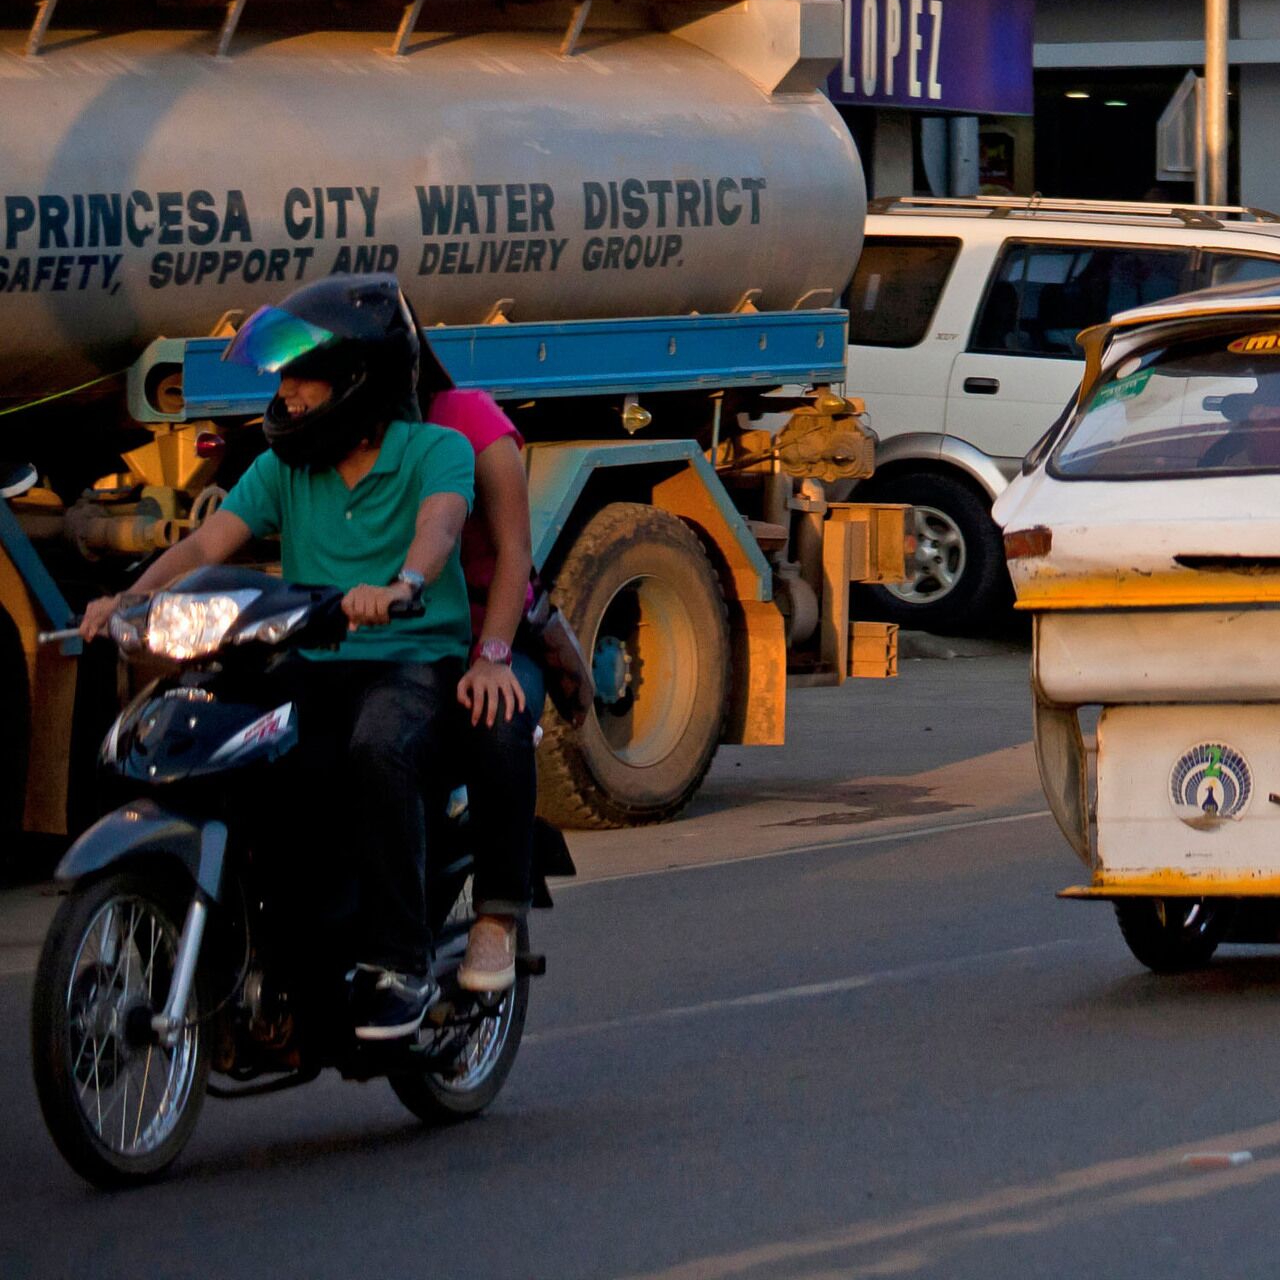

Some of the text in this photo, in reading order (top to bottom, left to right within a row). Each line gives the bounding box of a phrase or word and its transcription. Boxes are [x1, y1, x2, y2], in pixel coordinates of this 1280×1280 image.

[4, 175, 767, 250] PRINCESA CITY WATER DISTRICT
[148, 247, 315, 290] SUPPORT
[331, 244, 400, 275] AND
[418, 238, 569, 276] DELIVERY
[582, 234, 684, 272] GROUP.
[1204, 745, 1222, 778] 2
